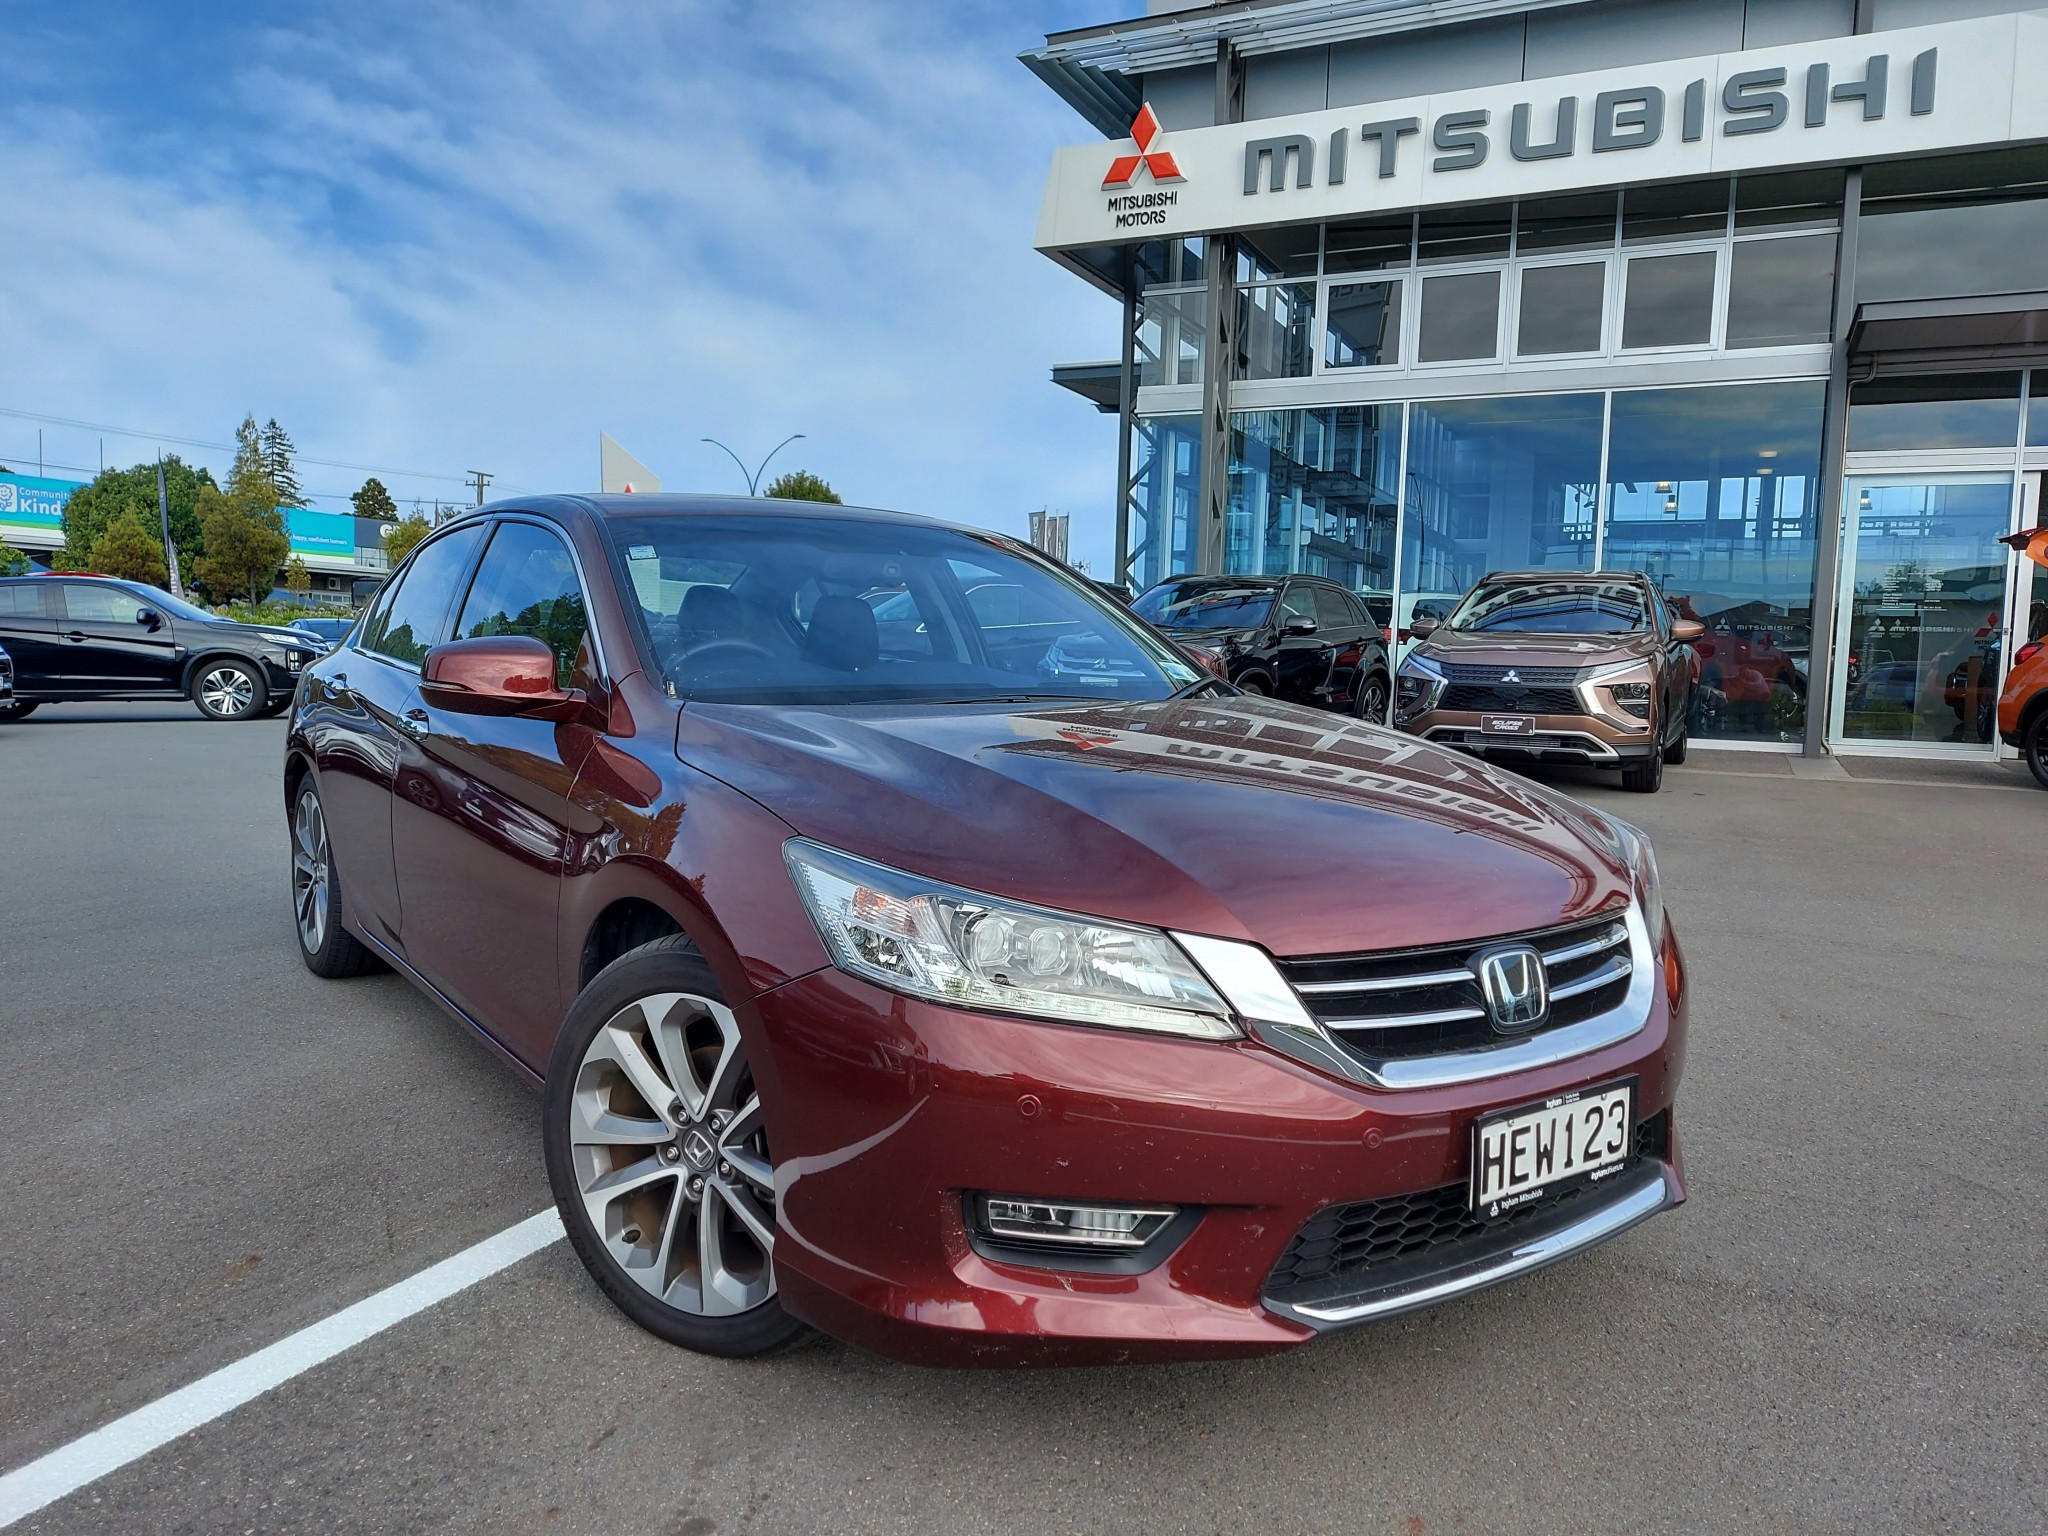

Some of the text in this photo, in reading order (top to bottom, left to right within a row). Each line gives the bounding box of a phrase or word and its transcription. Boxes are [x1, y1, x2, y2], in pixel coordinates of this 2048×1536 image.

[1243, 46, 1938, 196] MITSUBISHI
[1107, 190, 1178, 212] MITSUBISHI
[1115, 209, 1167, 228] MOTORS
[1491, 719, 1524, 727] ECLIPSE
[1481, 1099, 1626, 1196] HEW123
